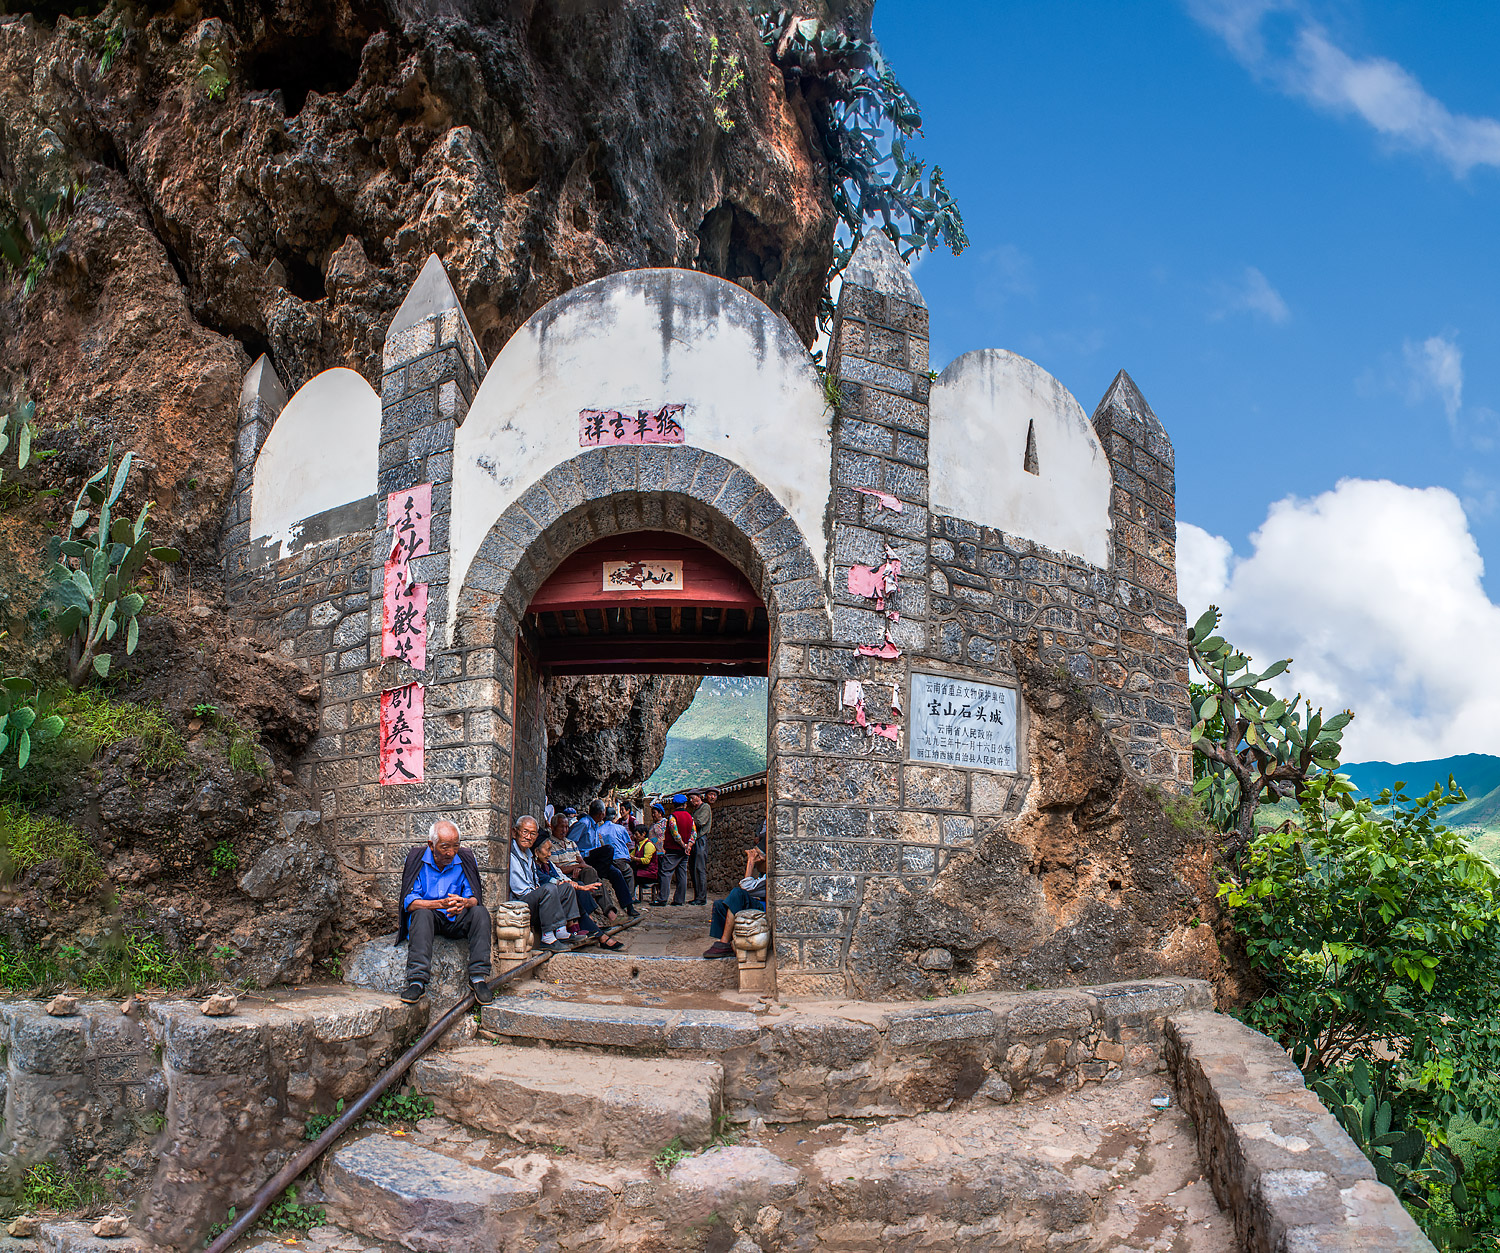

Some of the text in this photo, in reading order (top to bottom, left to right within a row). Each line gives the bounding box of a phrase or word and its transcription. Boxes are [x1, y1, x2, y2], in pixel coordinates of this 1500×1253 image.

[925, 681, 1006, 705] 云南省重点文物保护单位
[927, 699, 1004, 726] 宝山石头城
[937, 724, 993, 741] 云南省人民政府
[917, 736, 1011, 755] 一九九三年十一月十六日公布
[917, 748, 1010, 767] 丽江纳西族自治县人民政府立
